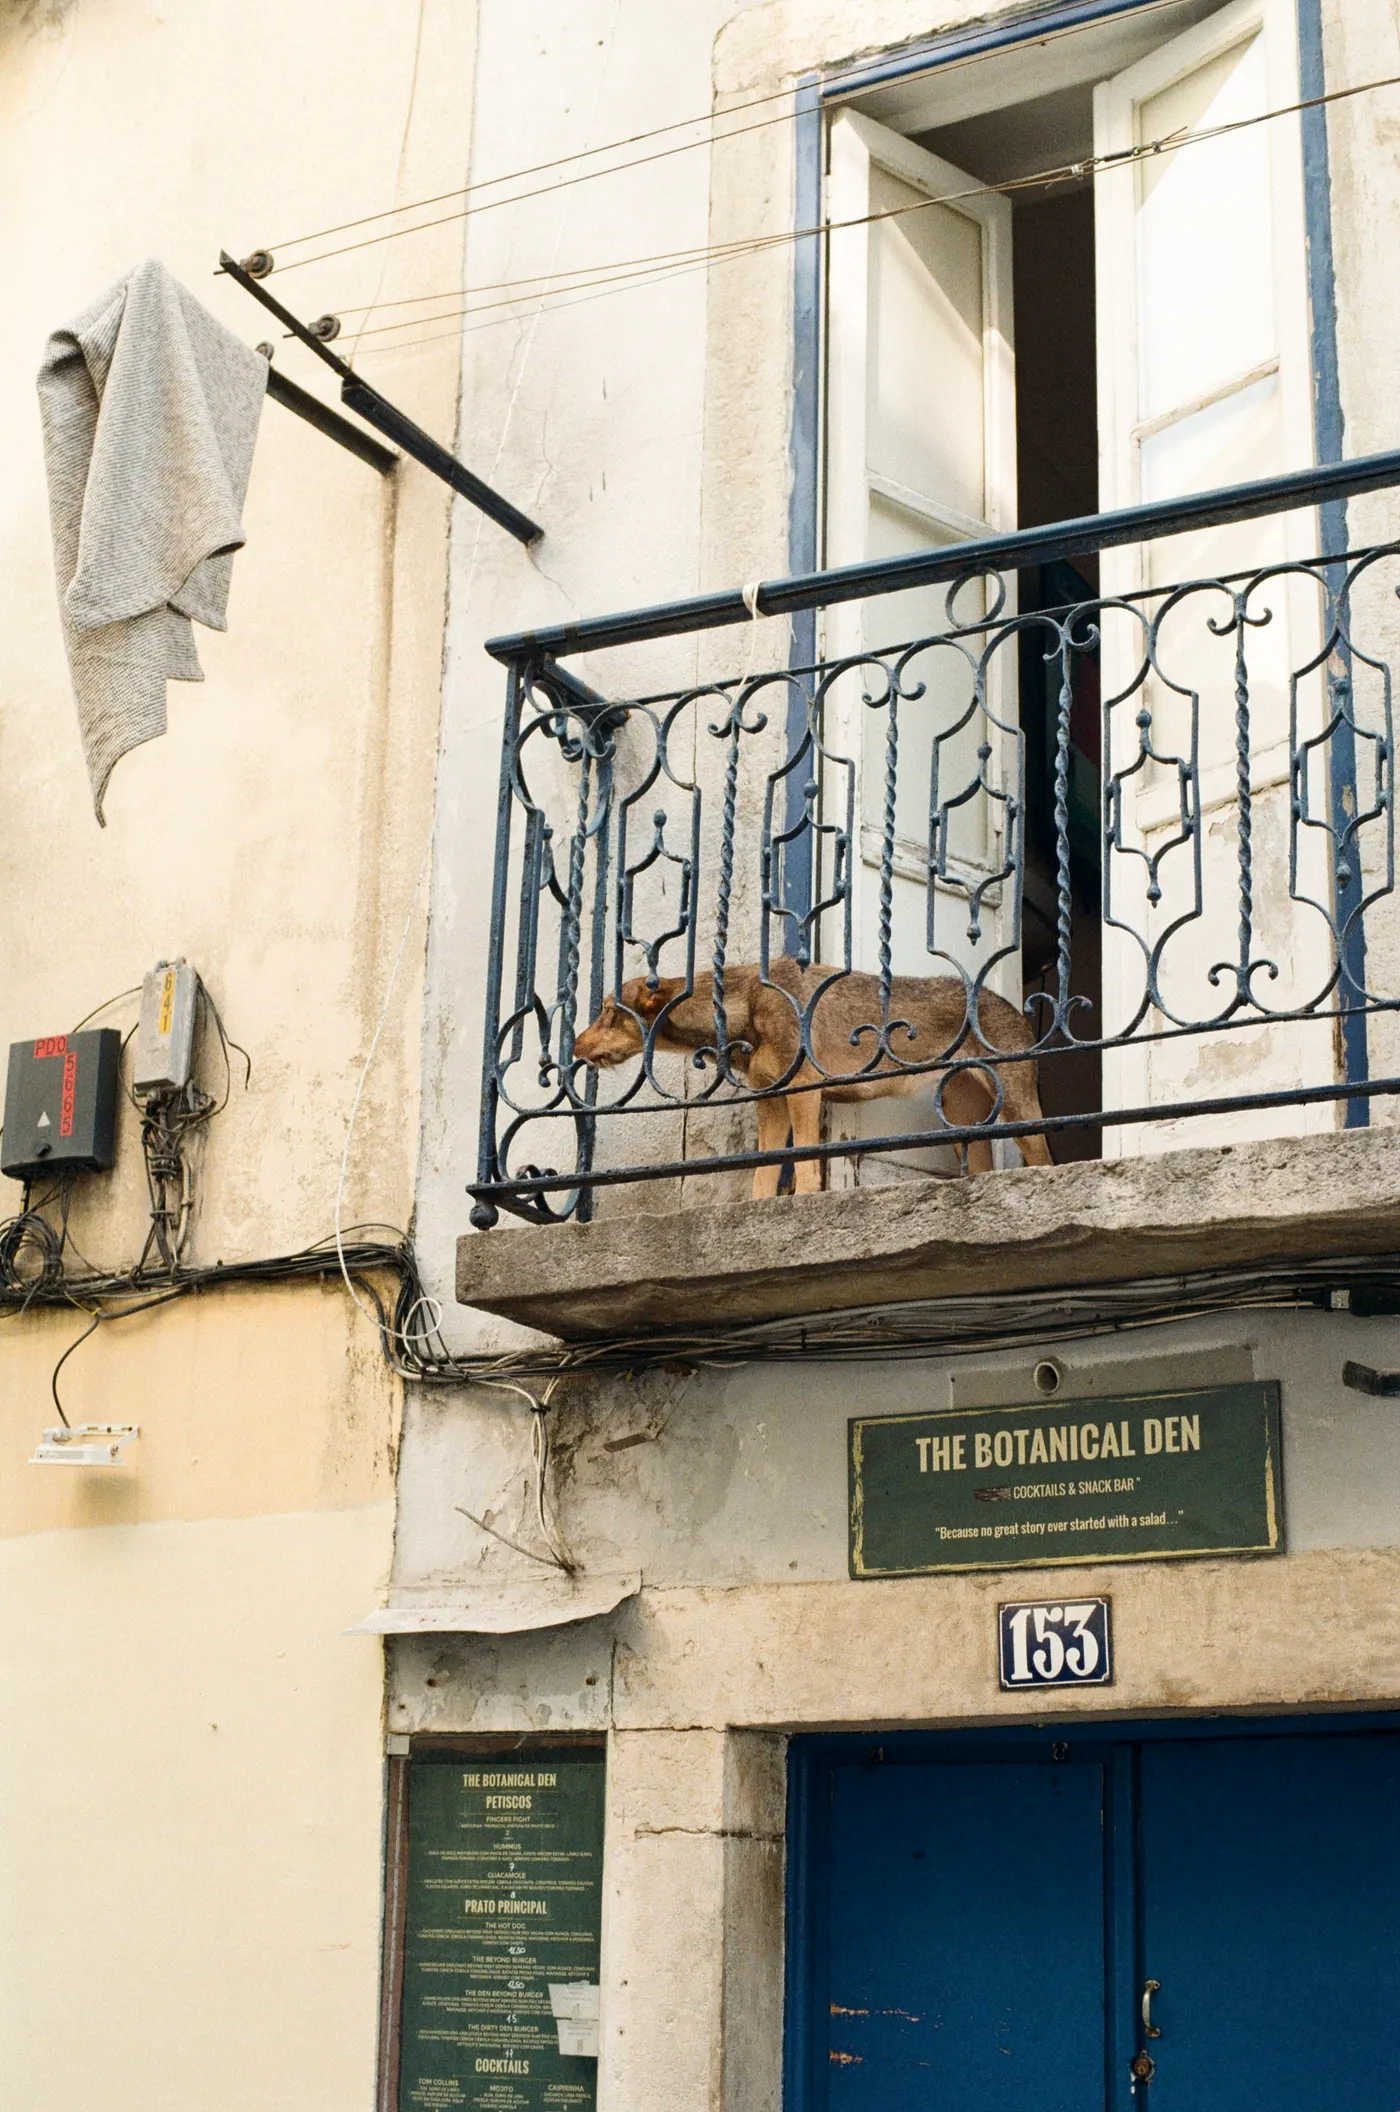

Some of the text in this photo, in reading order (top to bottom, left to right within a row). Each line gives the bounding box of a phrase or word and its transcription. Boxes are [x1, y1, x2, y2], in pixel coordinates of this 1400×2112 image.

[916, 1414, 1201, 1473] THE BOTANICAL DEN
[1013, 1483, 1067, 1500] COCKTAILS
[1068, 1483, 1076, 1495] &
[1078, 1480, 1112, 1495] SNACK
[935, 1526, 979, 1540] "Because
[981, 1528, 993, 1538] no
[994, 1522, 1019, 1539] great
[1021, 1521, 1045, 1537] story
[1047, 1521, 1069, 1533] ever
[1070, 1515, 1105, 1532] started
[1107, 1513, 1129, 1529] with
[1131, 1518, 1137, 1527] a
[1009, 1603, 1098, 1682] 153
[463, 1773, 557, 1787] THE BOTANICAL DEN
[486, 1795, 532, 1809] PETISCOS
[465, 1899, 547, 1915] PRATO PRINCIPAL
[512, 1922, 526, 1930] DOG
[492, 1990, 517, 1998] BEYOND
[475, 2058, 530, 2074] COCKTAILS
[433, 2078, 459, 2087] COLLINS
